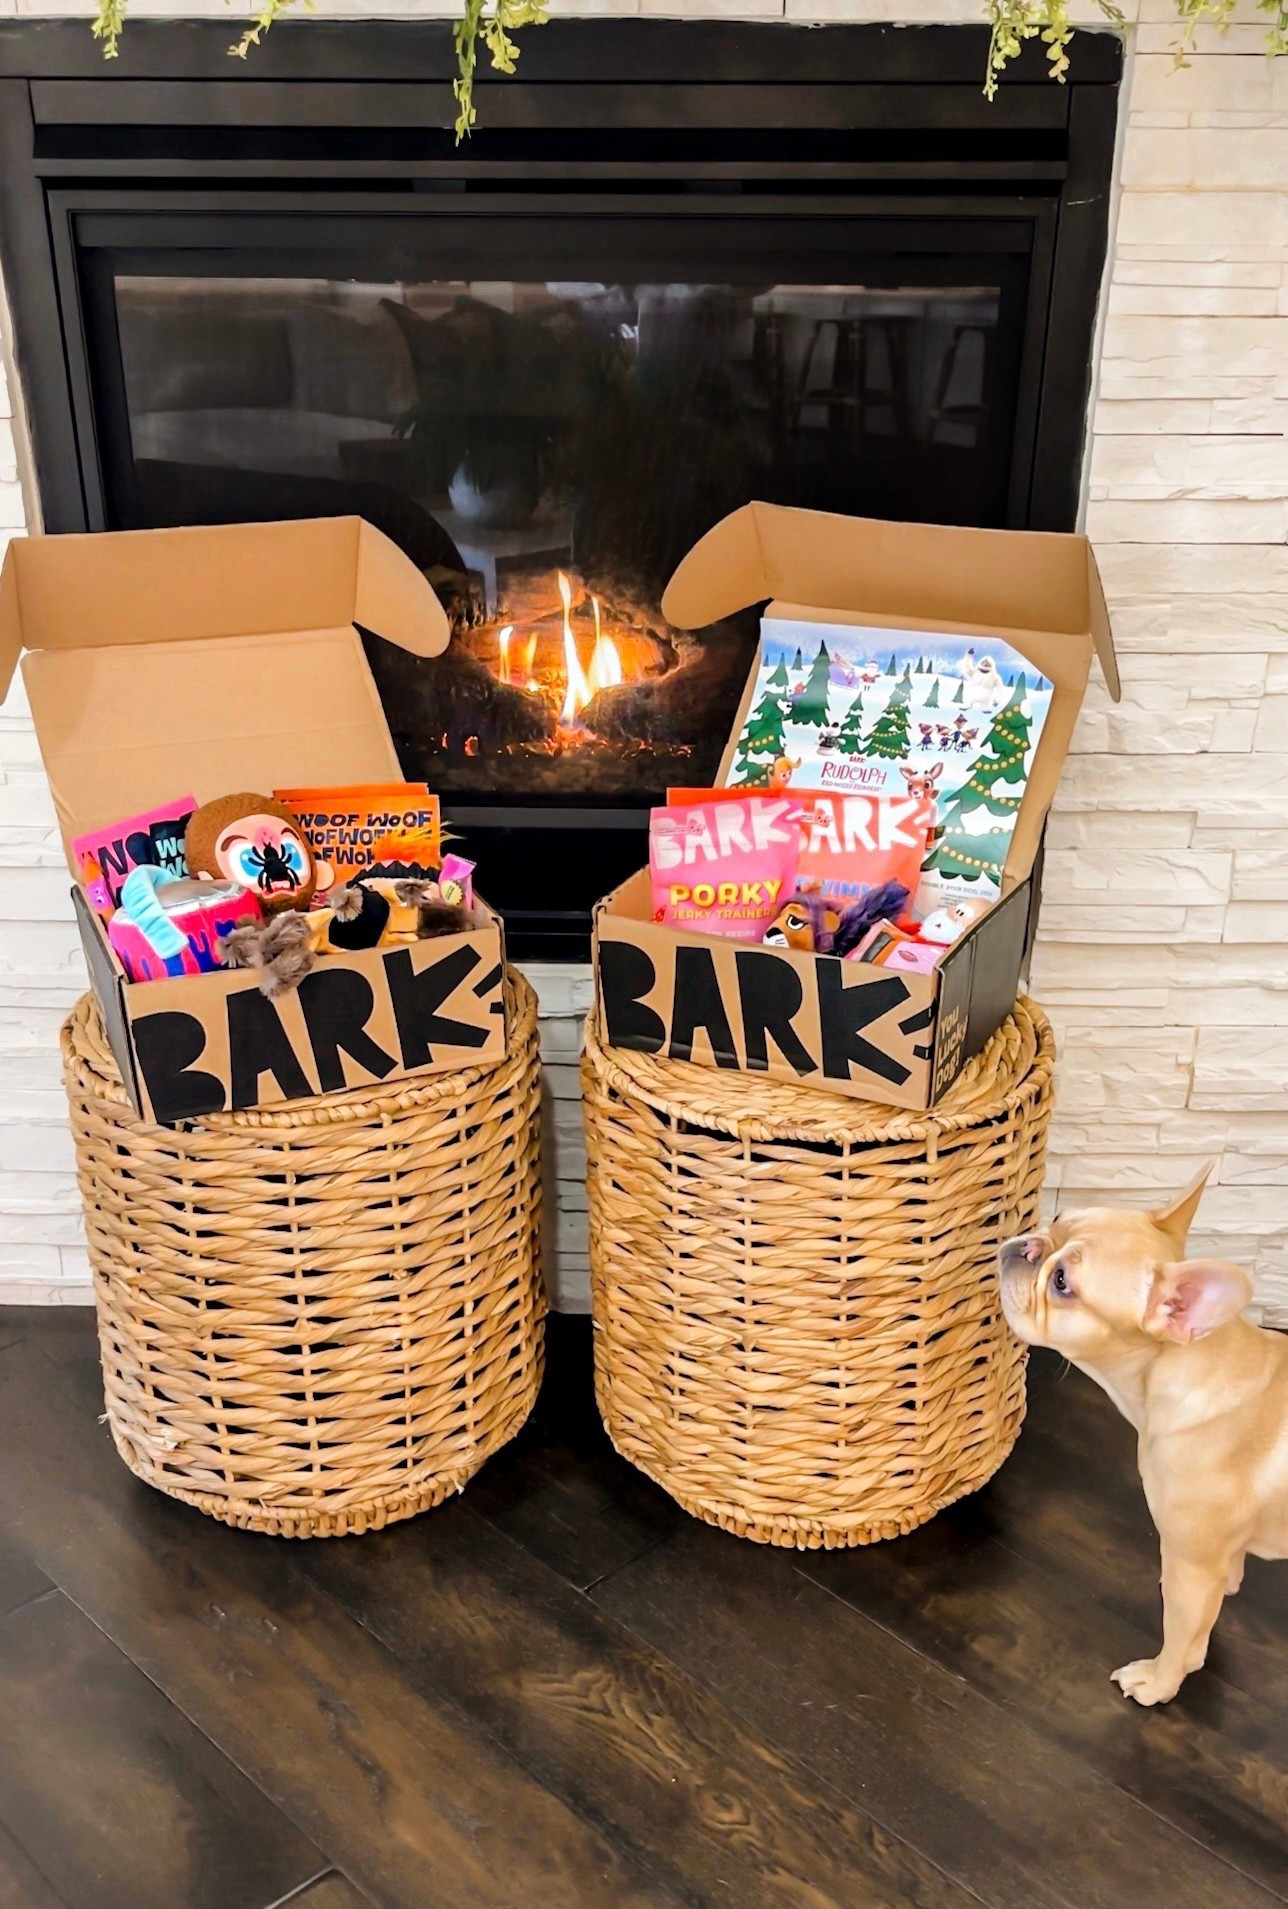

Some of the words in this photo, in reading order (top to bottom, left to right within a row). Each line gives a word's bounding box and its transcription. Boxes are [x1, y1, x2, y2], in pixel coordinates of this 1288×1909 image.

[821, 761, 887, 785] RUDOLPH
[652, 797, 791, 870] BARK
[800, 797, 918, 854] ARK
[670, 879, 782, 908] PORKY
[672, 909, 712, 921] JERKY
[725, 930, 756, 938] RECIPE
[131, 943, 490, 1123] BARK
[599, 940, 912, 1086] BARK
